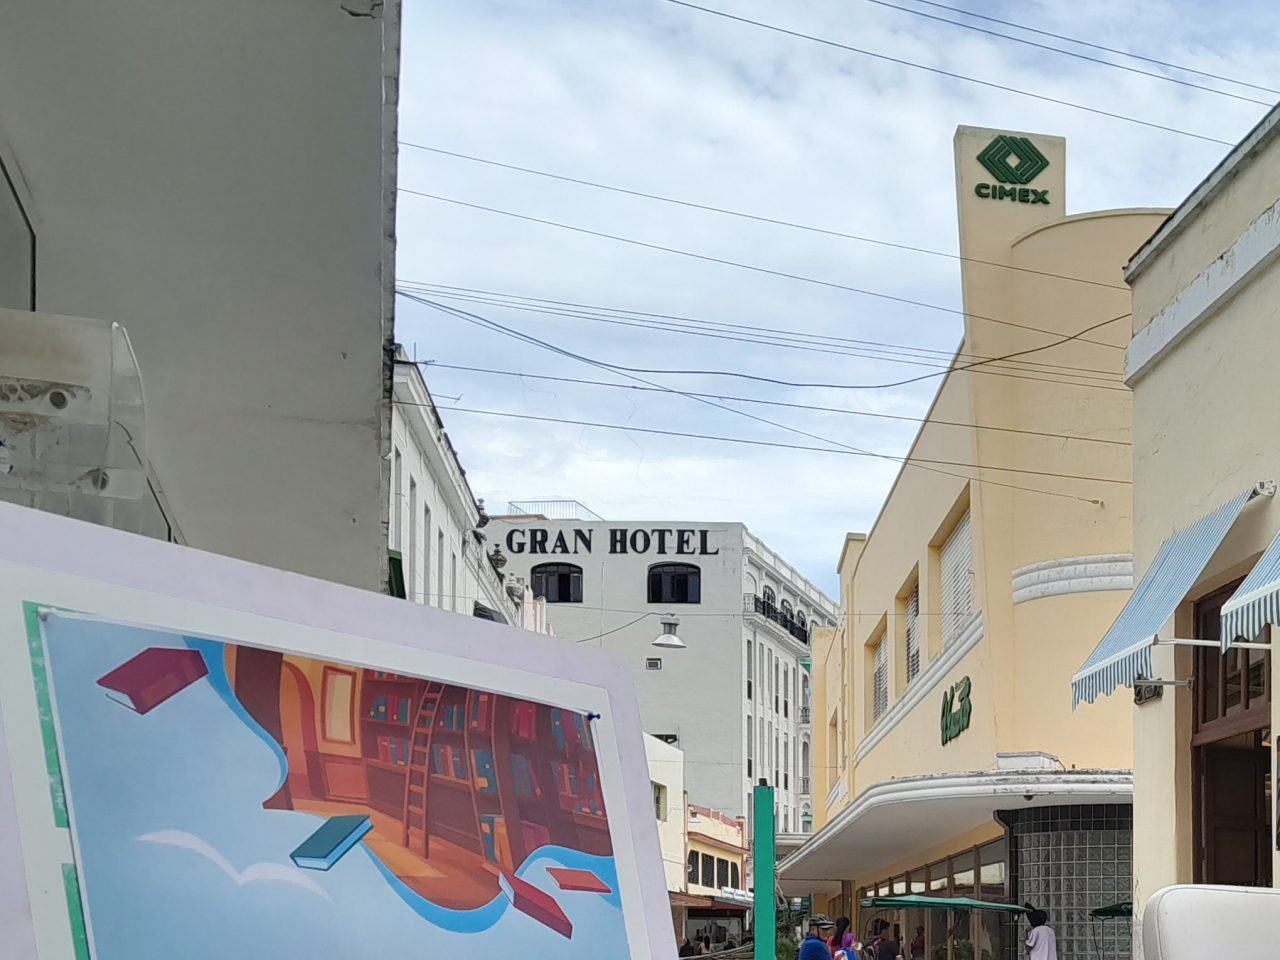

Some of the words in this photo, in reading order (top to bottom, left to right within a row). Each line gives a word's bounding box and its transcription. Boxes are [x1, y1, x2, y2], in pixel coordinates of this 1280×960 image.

[975, 183, 1050, 205] CIMEX
[506, 528, 593, 554] GRAN
[608, 528, 719, 556] HOTEL
